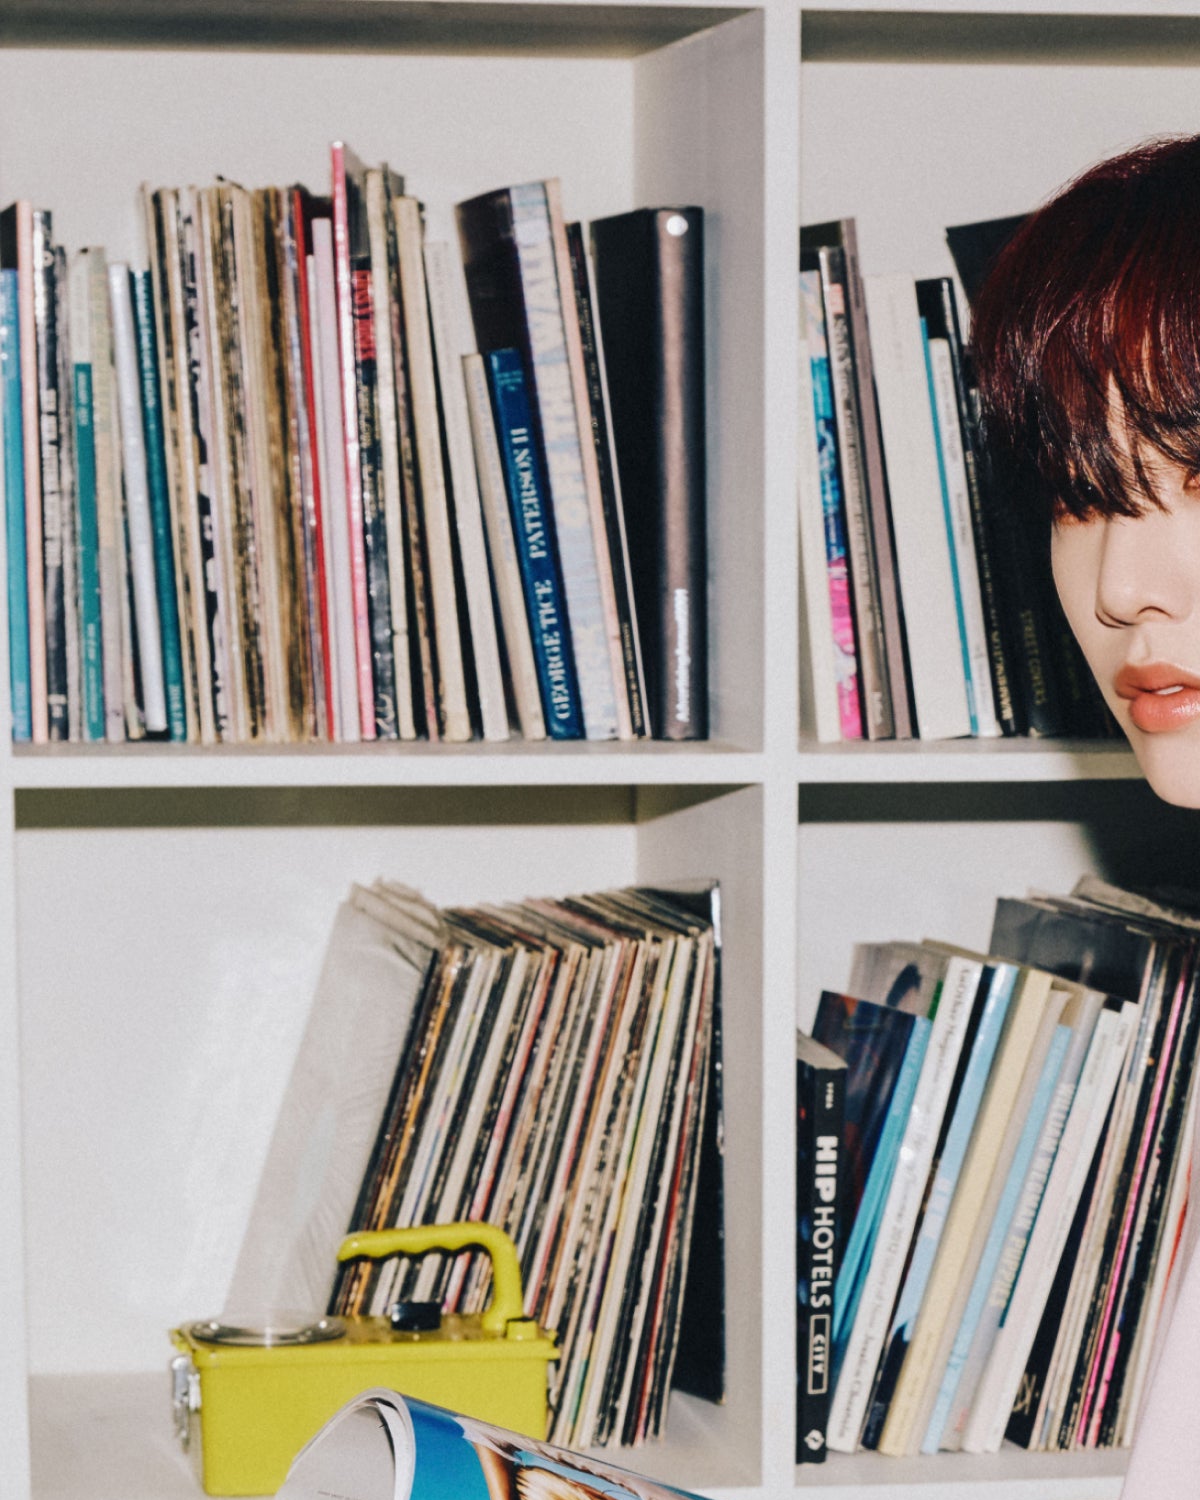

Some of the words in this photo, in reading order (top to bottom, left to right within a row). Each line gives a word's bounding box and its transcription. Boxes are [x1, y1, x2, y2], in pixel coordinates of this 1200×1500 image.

[511, 447, 548, 559] PATERSON
[532, 579, 560, 631] TICE
[538, 633, 574, 720] GEORGE
[1041, 1083, 1077, 1154] WILLIAM
[814, 1135, 839, 1202] HIP
[810, 1206, 837, 1309] HOTELS
[989, 1235, 1030, 1309] PUPPIES
[812, 1333, 826, 1375] CITY
